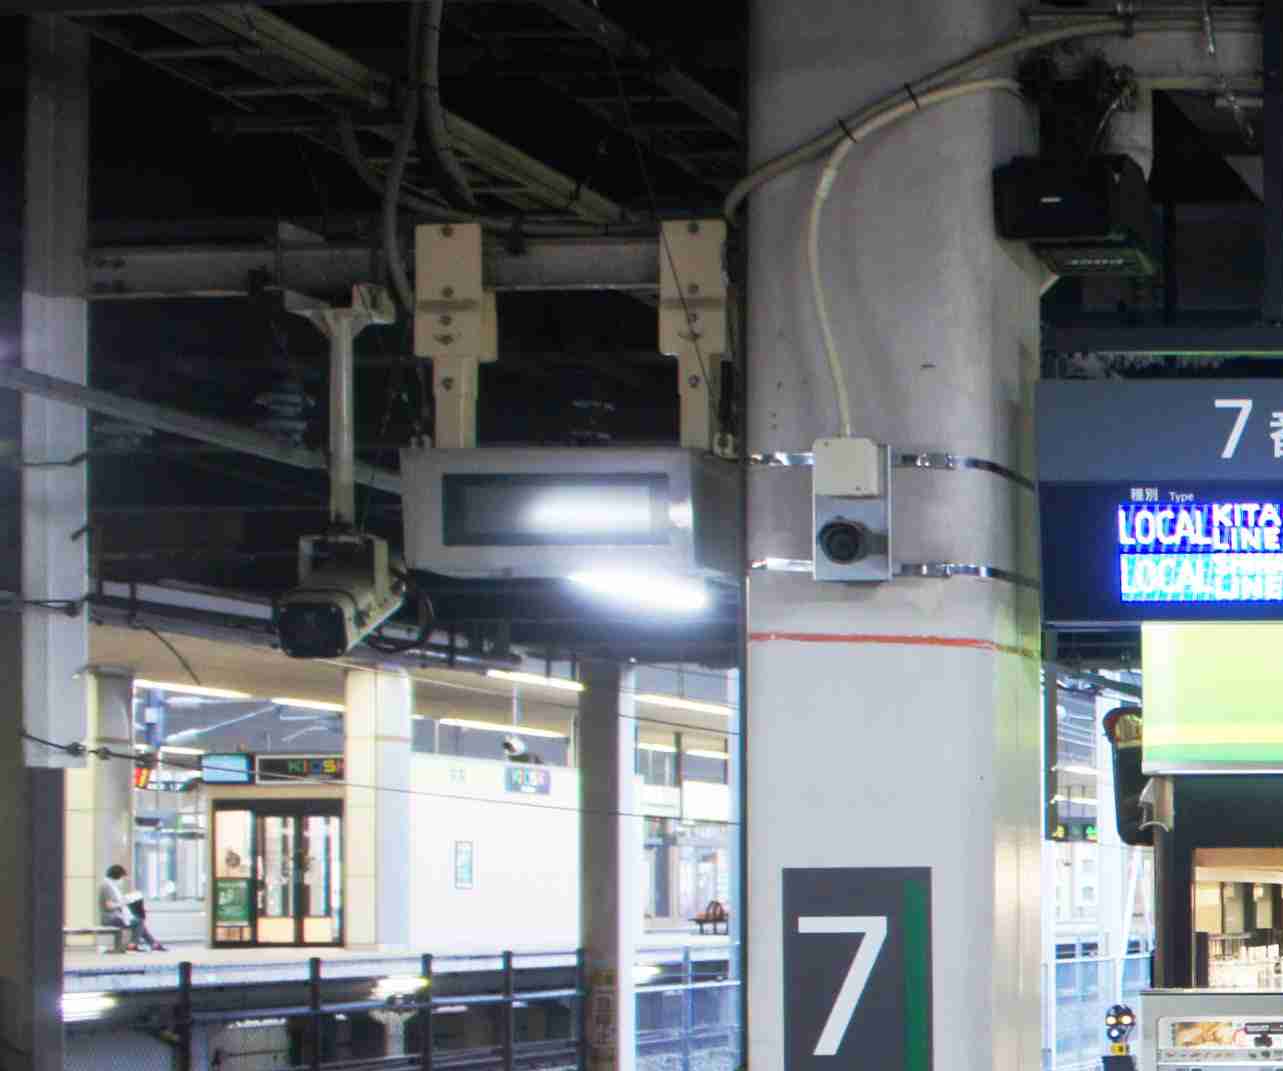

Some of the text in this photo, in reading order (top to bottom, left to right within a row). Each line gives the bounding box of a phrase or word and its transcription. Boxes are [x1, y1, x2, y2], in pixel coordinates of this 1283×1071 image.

[1168, 492, 1195, 506] Type
[1119, 509, 1212, 546] LOCAL
[1213, 527, 1281, 551] LINE
[1121, 558, 1214, 594] LOCAL
[1214, 575, 1282, 599] LINE
[797, 916, 888, 1056] 7
